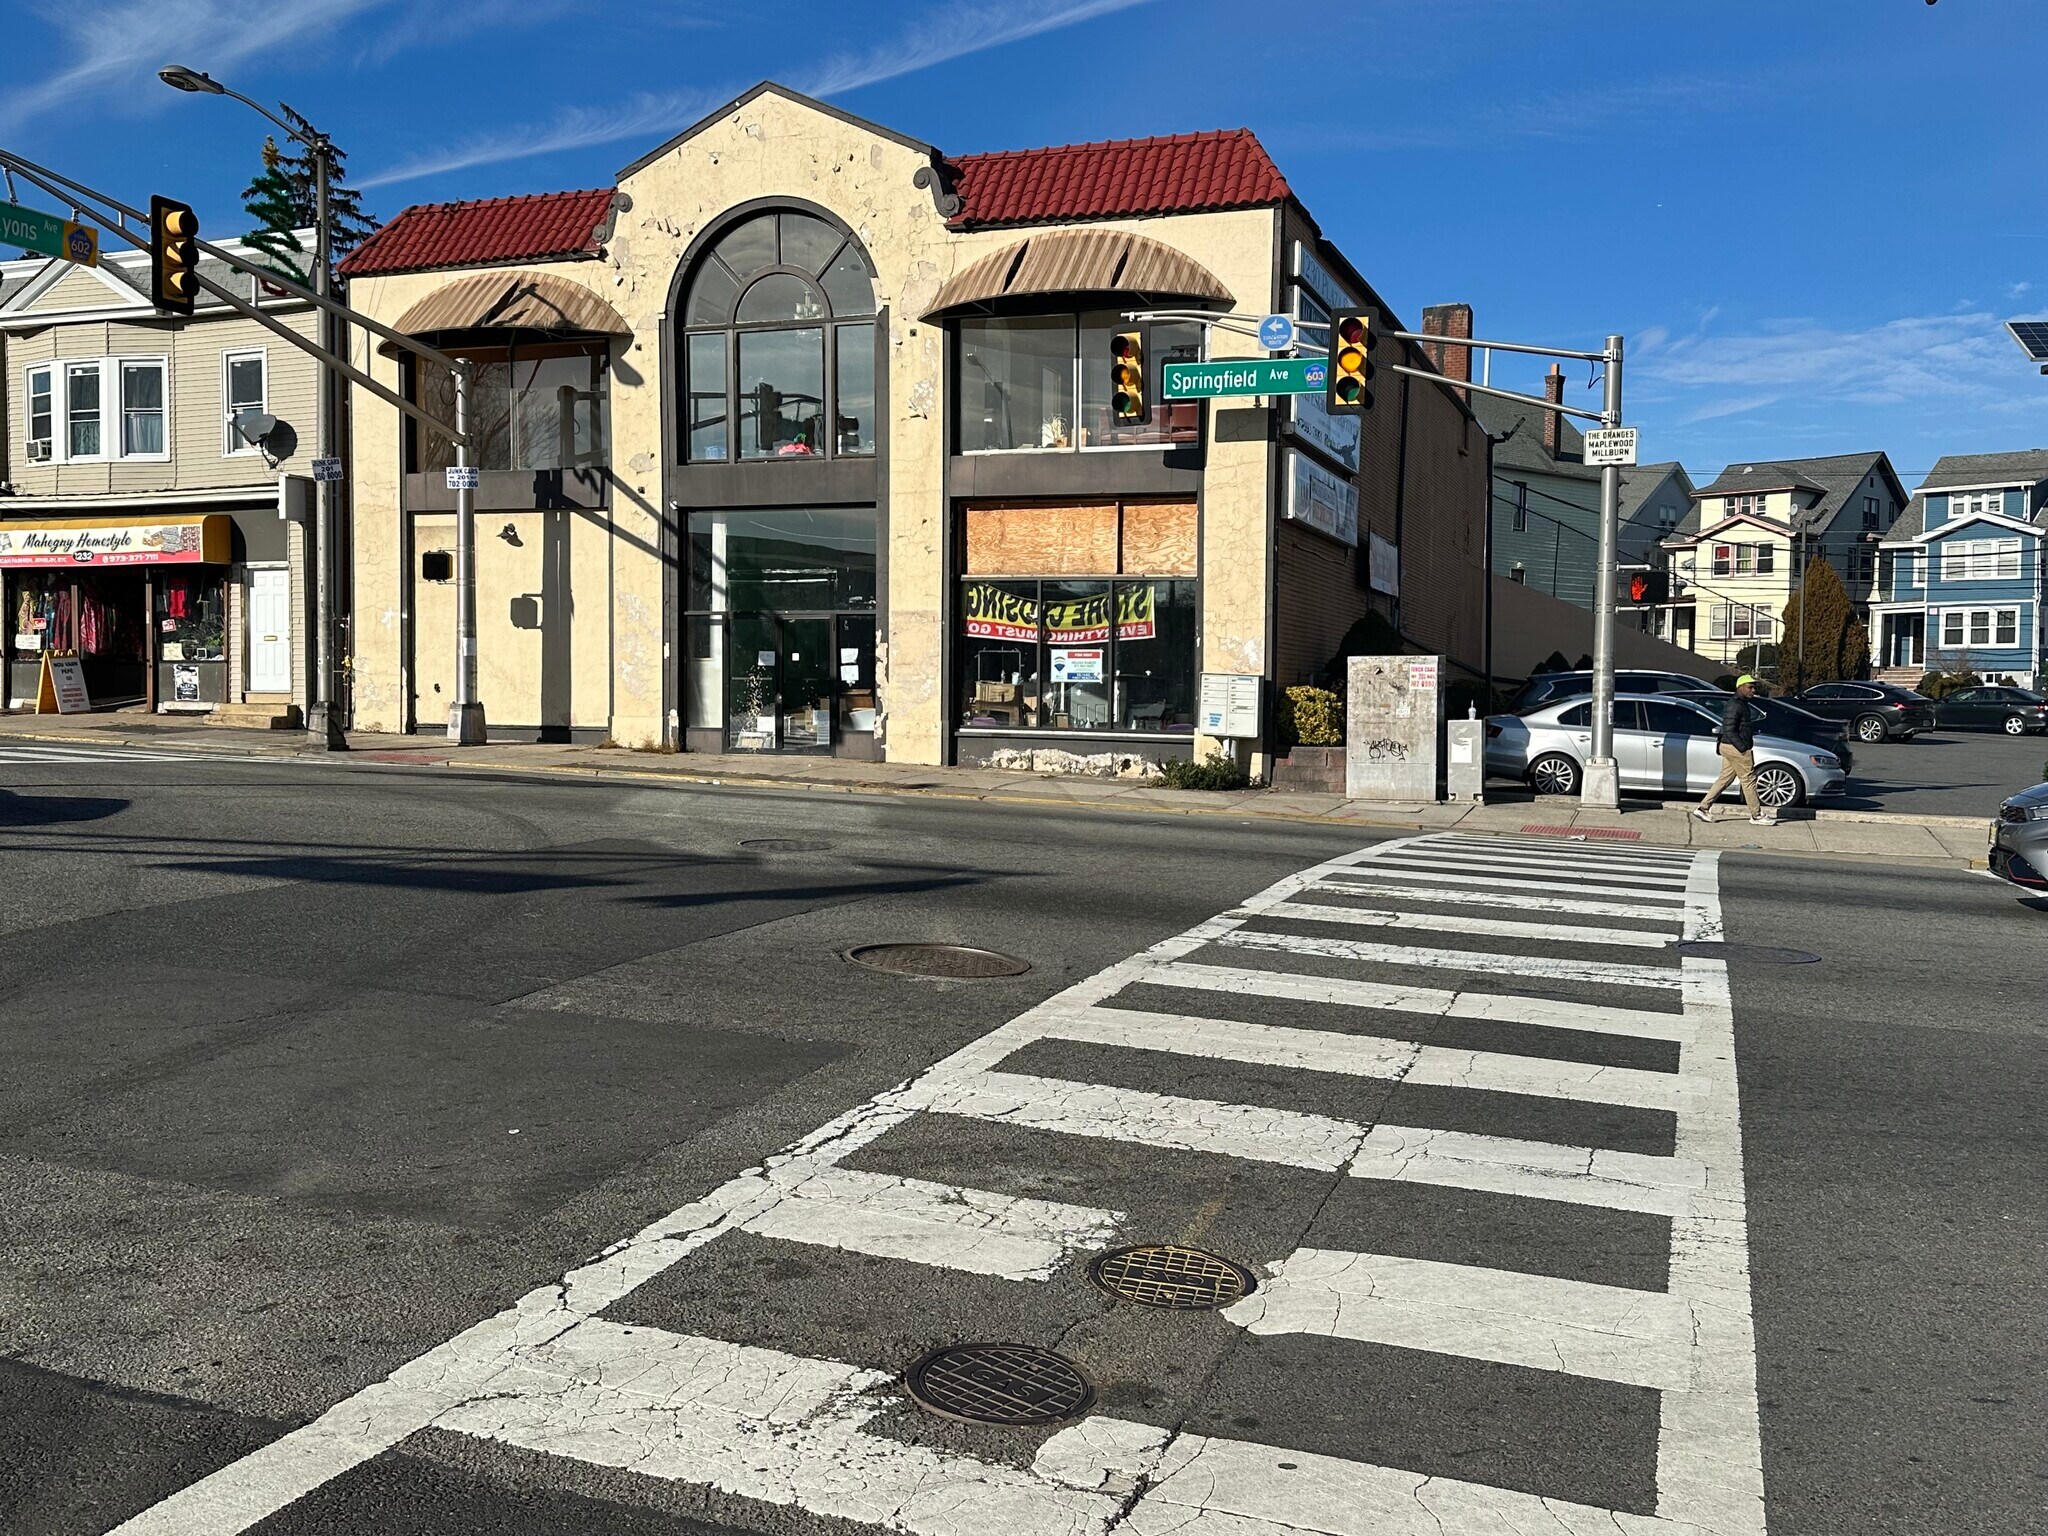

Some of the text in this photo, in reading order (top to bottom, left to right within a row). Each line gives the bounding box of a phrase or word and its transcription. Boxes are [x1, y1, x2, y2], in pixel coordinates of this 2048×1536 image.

[0, 217, 58, 241] yons Ave
[71, 240, 91, 255] 602
[1171, 368, 1290, 394] Springfield Ave
[1306, 371, 1324, 381] 603
[1588, 430, 1634, 440] THE ORANGES
[1588, 439, 1634, 448] MAPLEWOOD
[1592, 448, 1629, 457] MILLBURN
[22, 531, 132, 553] Mahogny Homestyle
[1142, 1269, 1204, 1285] GAS
[971, 1369, 1036, 1397] GAS
